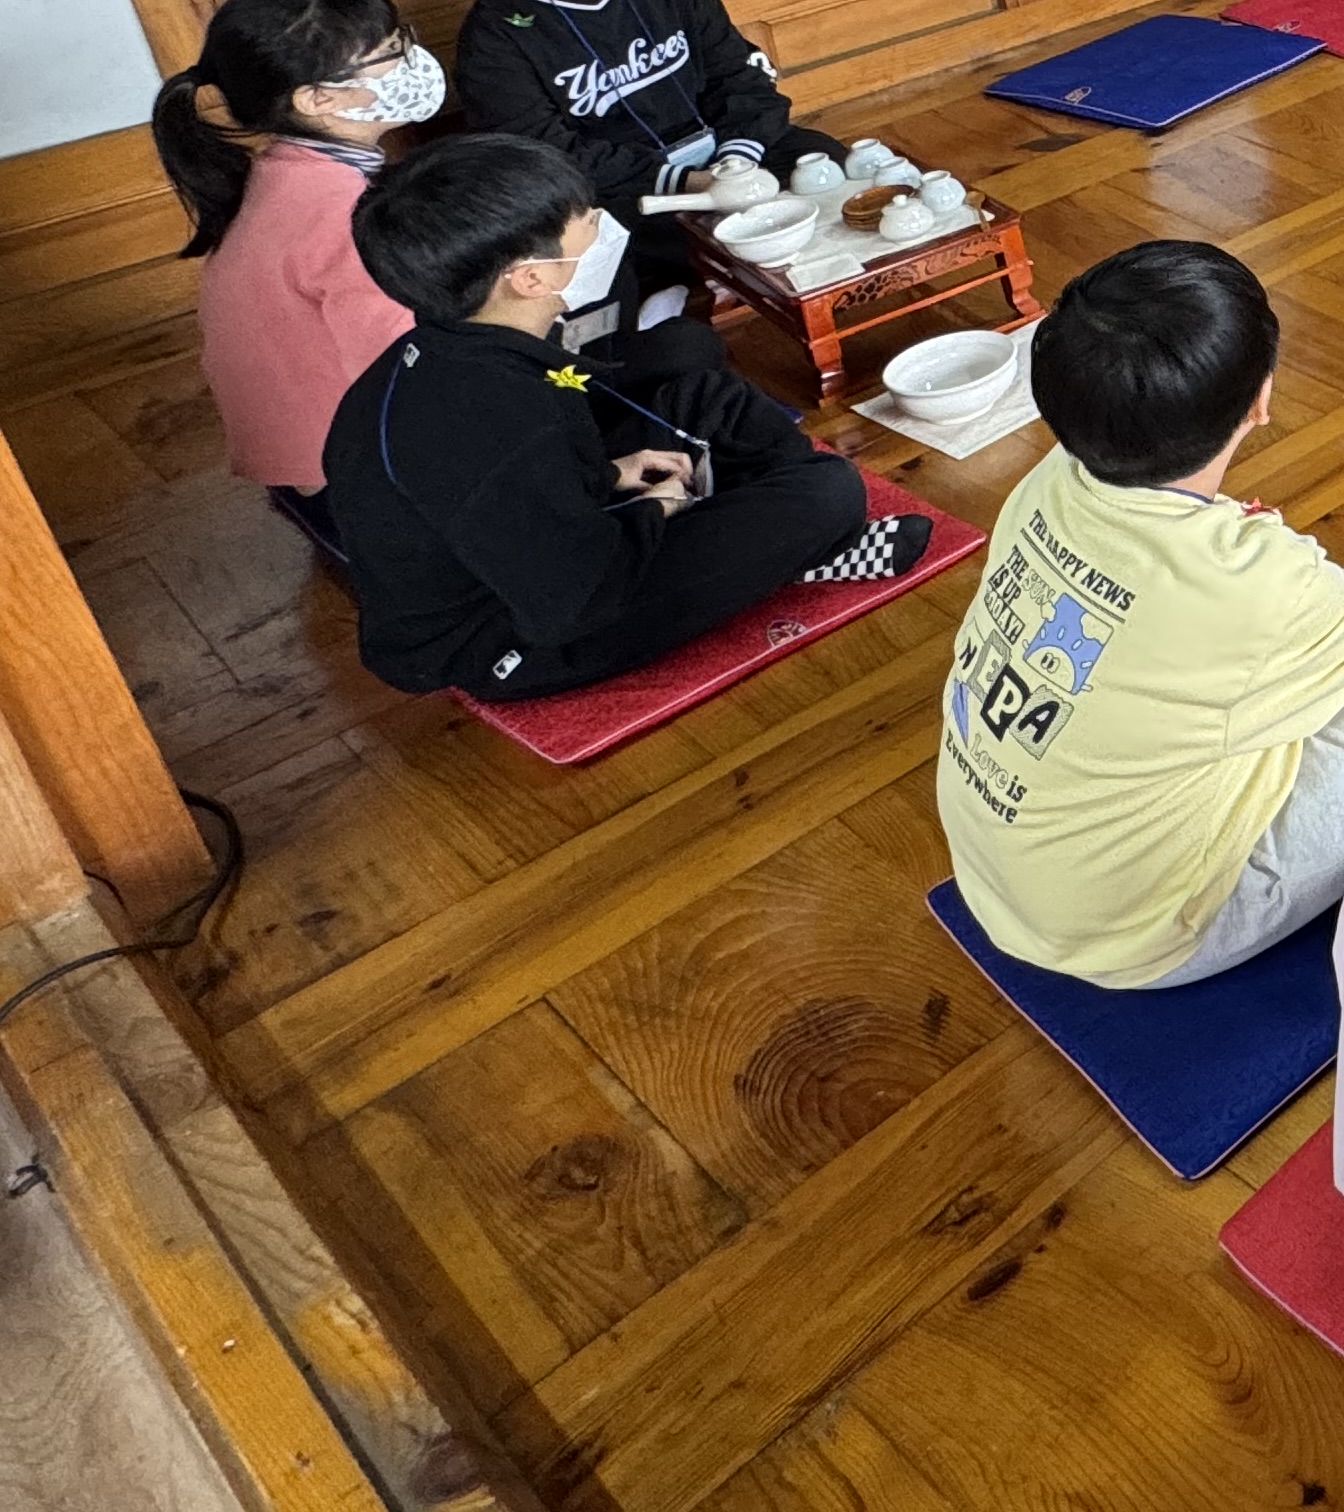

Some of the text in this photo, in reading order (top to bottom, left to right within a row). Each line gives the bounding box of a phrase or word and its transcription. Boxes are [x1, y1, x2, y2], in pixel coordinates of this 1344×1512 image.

[554, 29, 690, 117] Yankees
[1002, 576, 1022, 605] UP
[1006, 544, 1057, 606] THE SUN
[1080, 568, 1136, 612] NEWS
[945, 727, 1018, 824] Everywhere
[969, 732, 1028, 803] Love is
